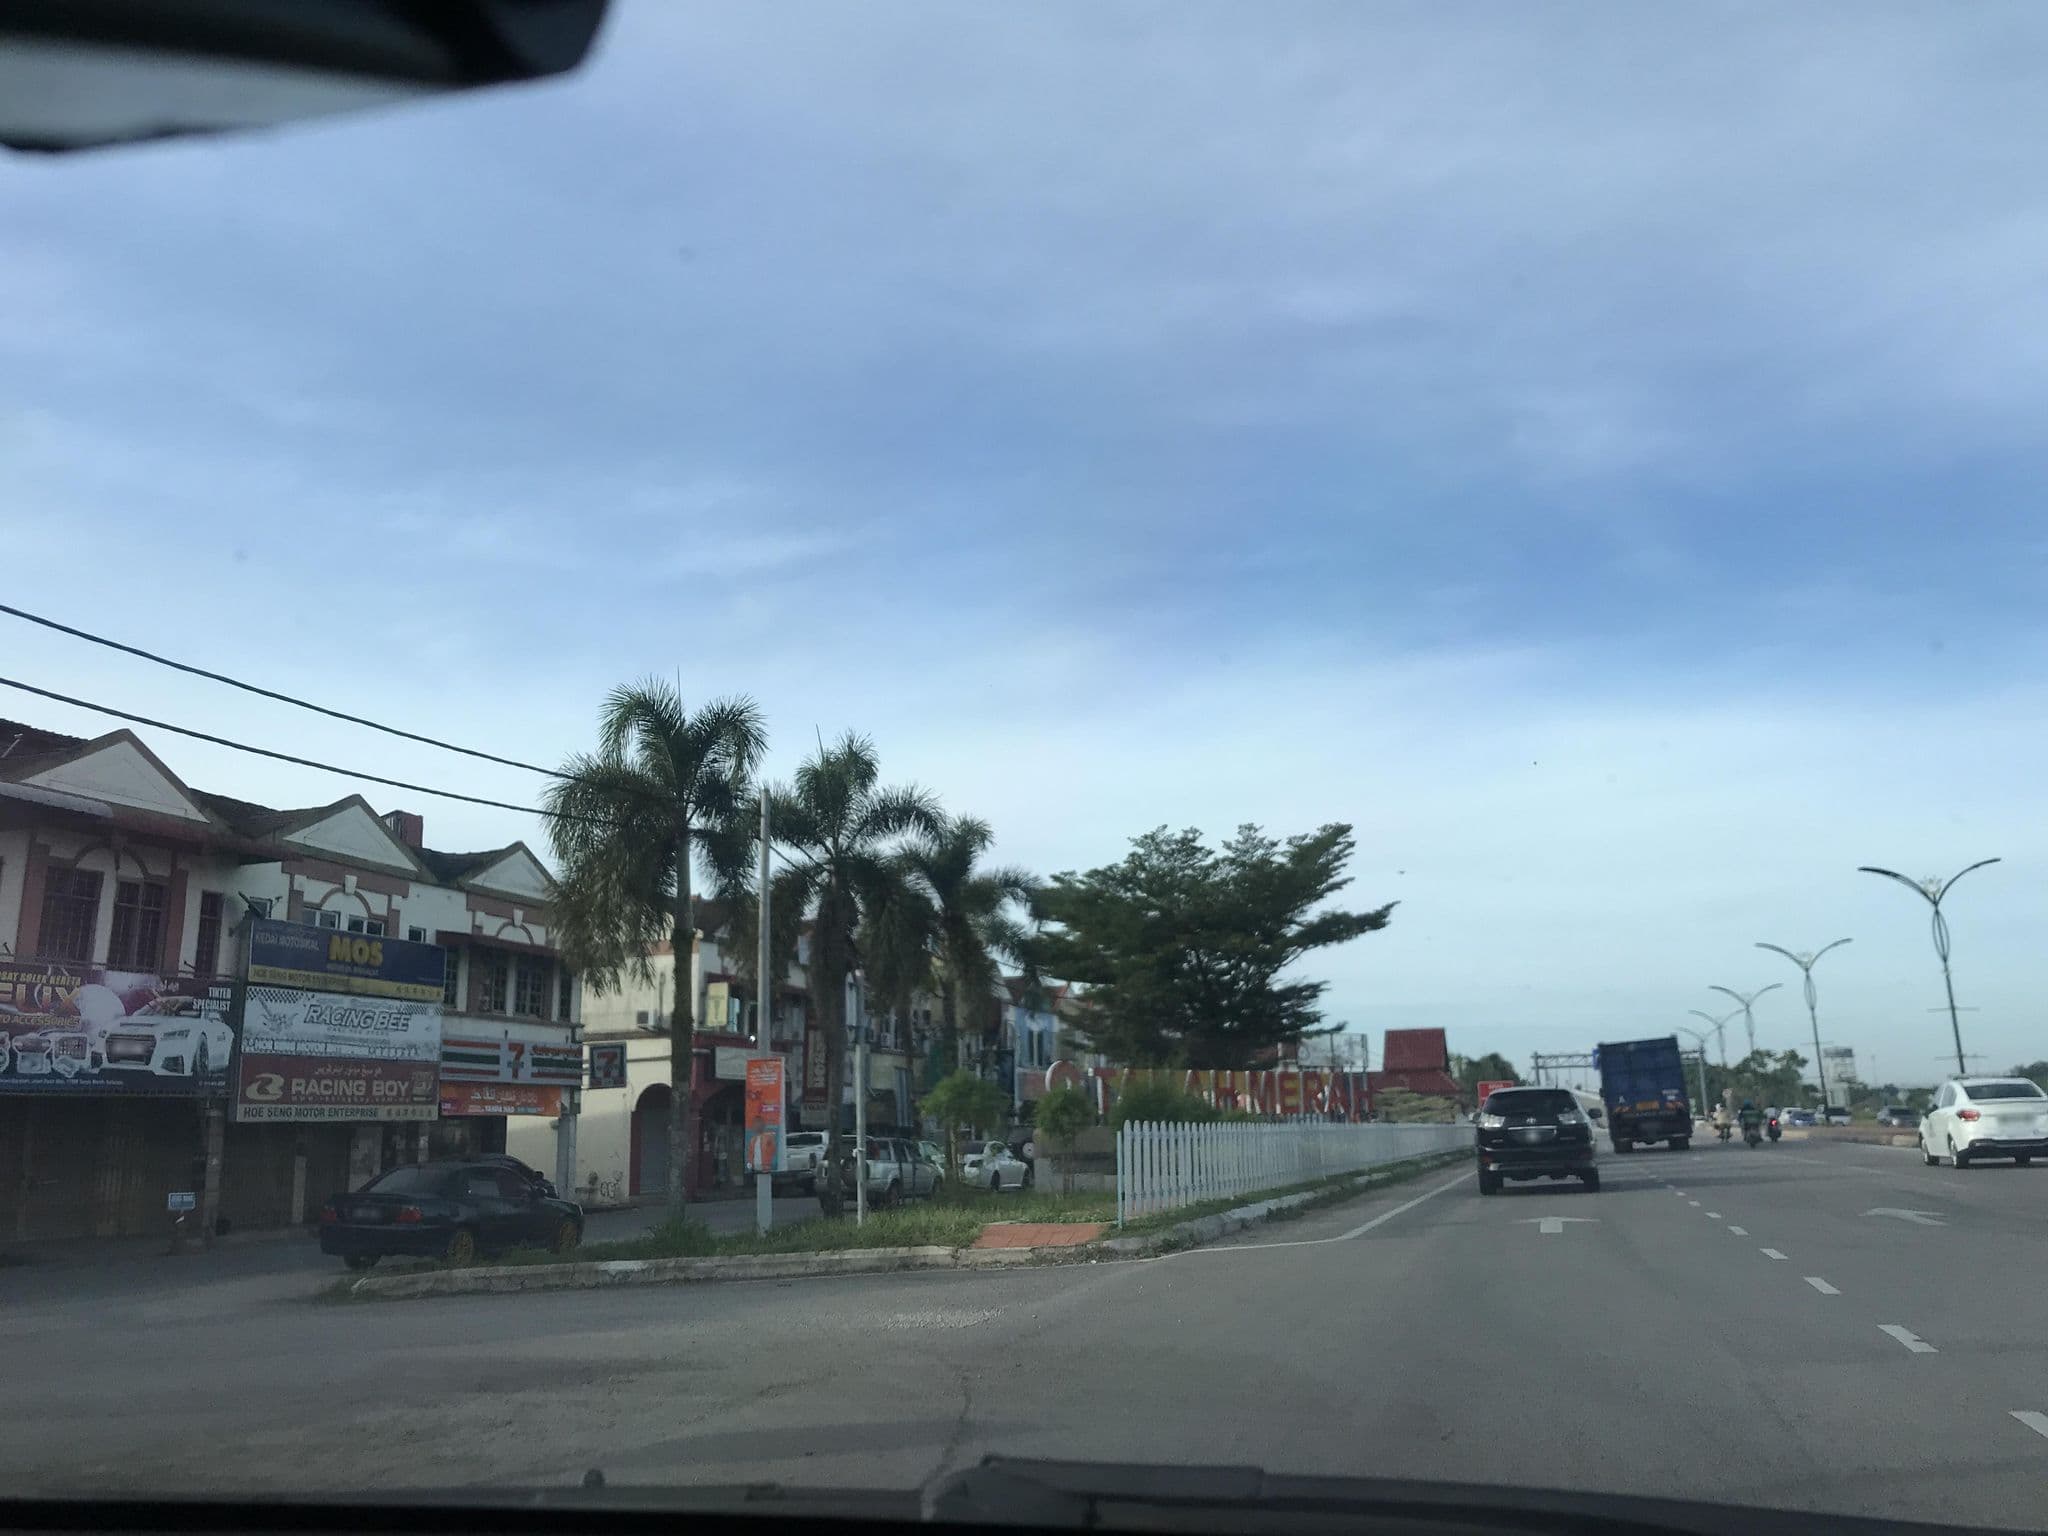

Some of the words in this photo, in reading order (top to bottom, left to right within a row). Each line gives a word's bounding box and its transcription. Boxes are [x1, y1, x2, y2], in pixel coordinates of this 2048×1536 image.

[329, 934, 383, 967] MOS
[192, 998, 231, 1012] SPECIALIST
[303, 1003, 374, 1030] RACING
[374, 1011, 412, 1033] BEE
[290, 1078, 367, 1097] RACING
[372, 1079, 411, 1098] BOY
[1243, 1069, 1376, 1123] MERAH
[243, 1106, 266, 1119] HOE
[267, 1106, 293, 1119] SENG
[294, 1106, 326, 1119] MOTOR
[327, 1106, 379, 1119] ENTERPRISE
